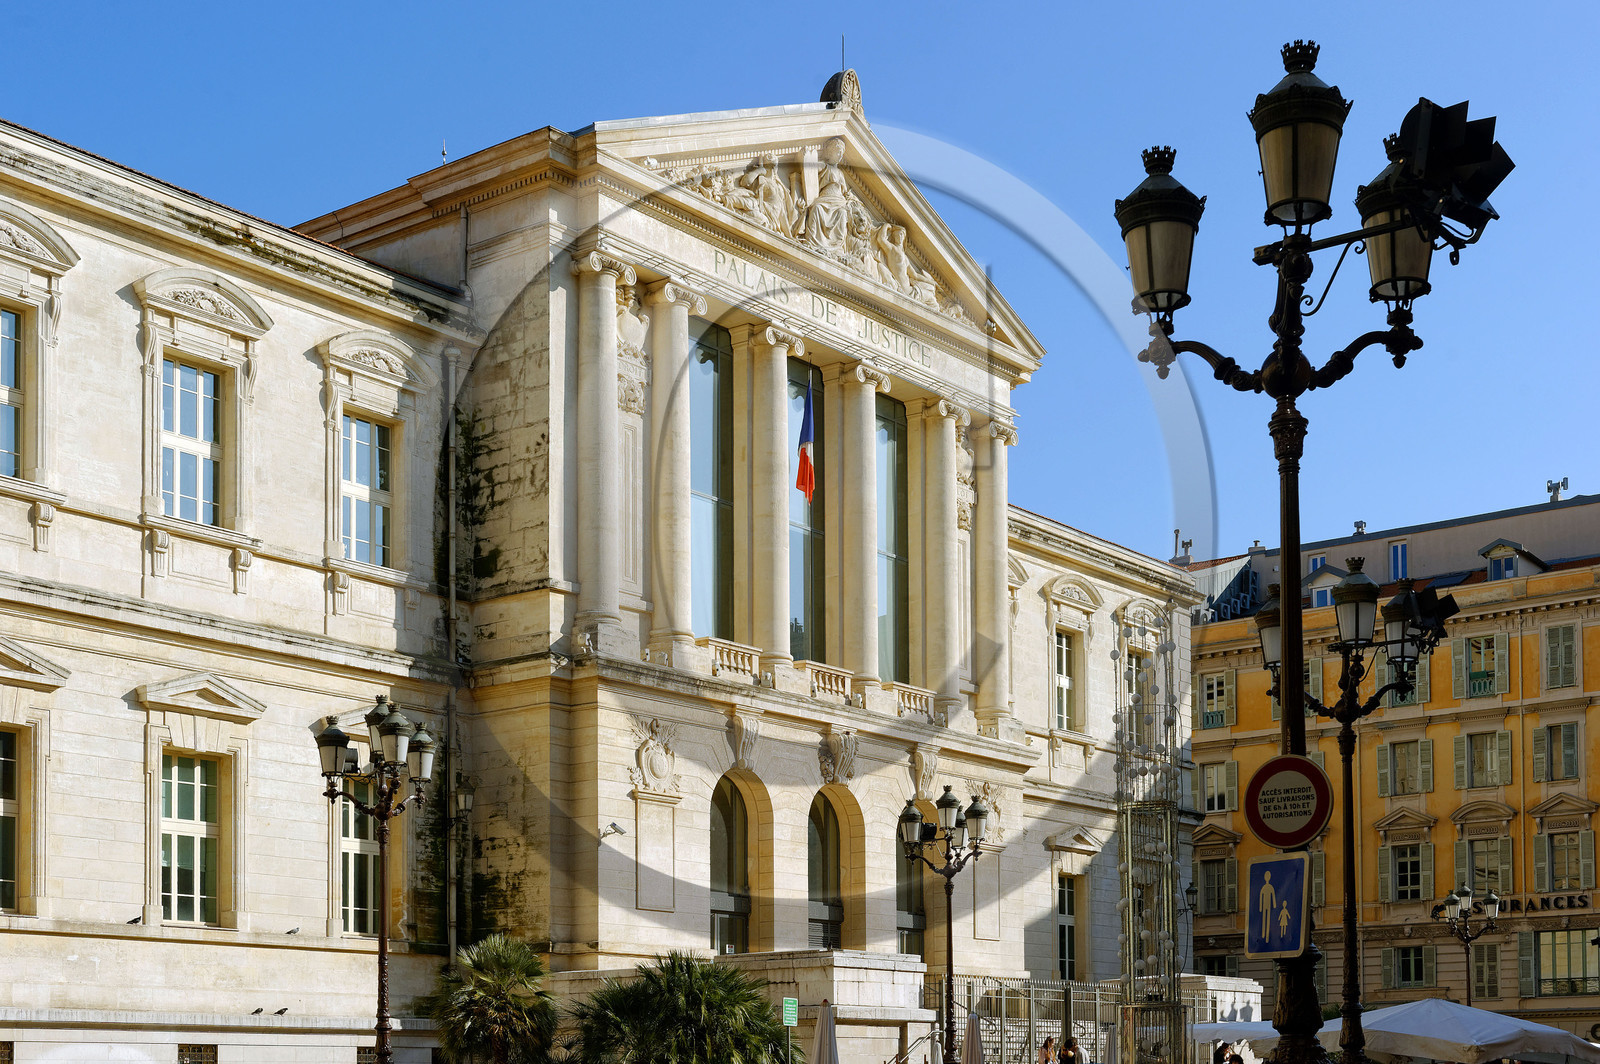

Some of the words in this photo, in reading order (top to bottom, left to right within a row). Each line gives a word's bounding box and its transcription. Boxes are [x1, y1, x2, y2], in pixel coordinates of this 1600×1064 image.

[714, 249, 789, 305] PALAIS
[811, 295, 837, 326] DE
[857, 318, 931, 369] JUSTICE
[1261, 788, 1282, 796] ACCÈS
[1283, 786, 1311, 794] INTERDIT
[1277, 794, 1315, 803] LIVRAISONS
[1262, 810, 1312, 819] AUTORISATIONS
[1472, 895, 1589, 914] SURANCES
